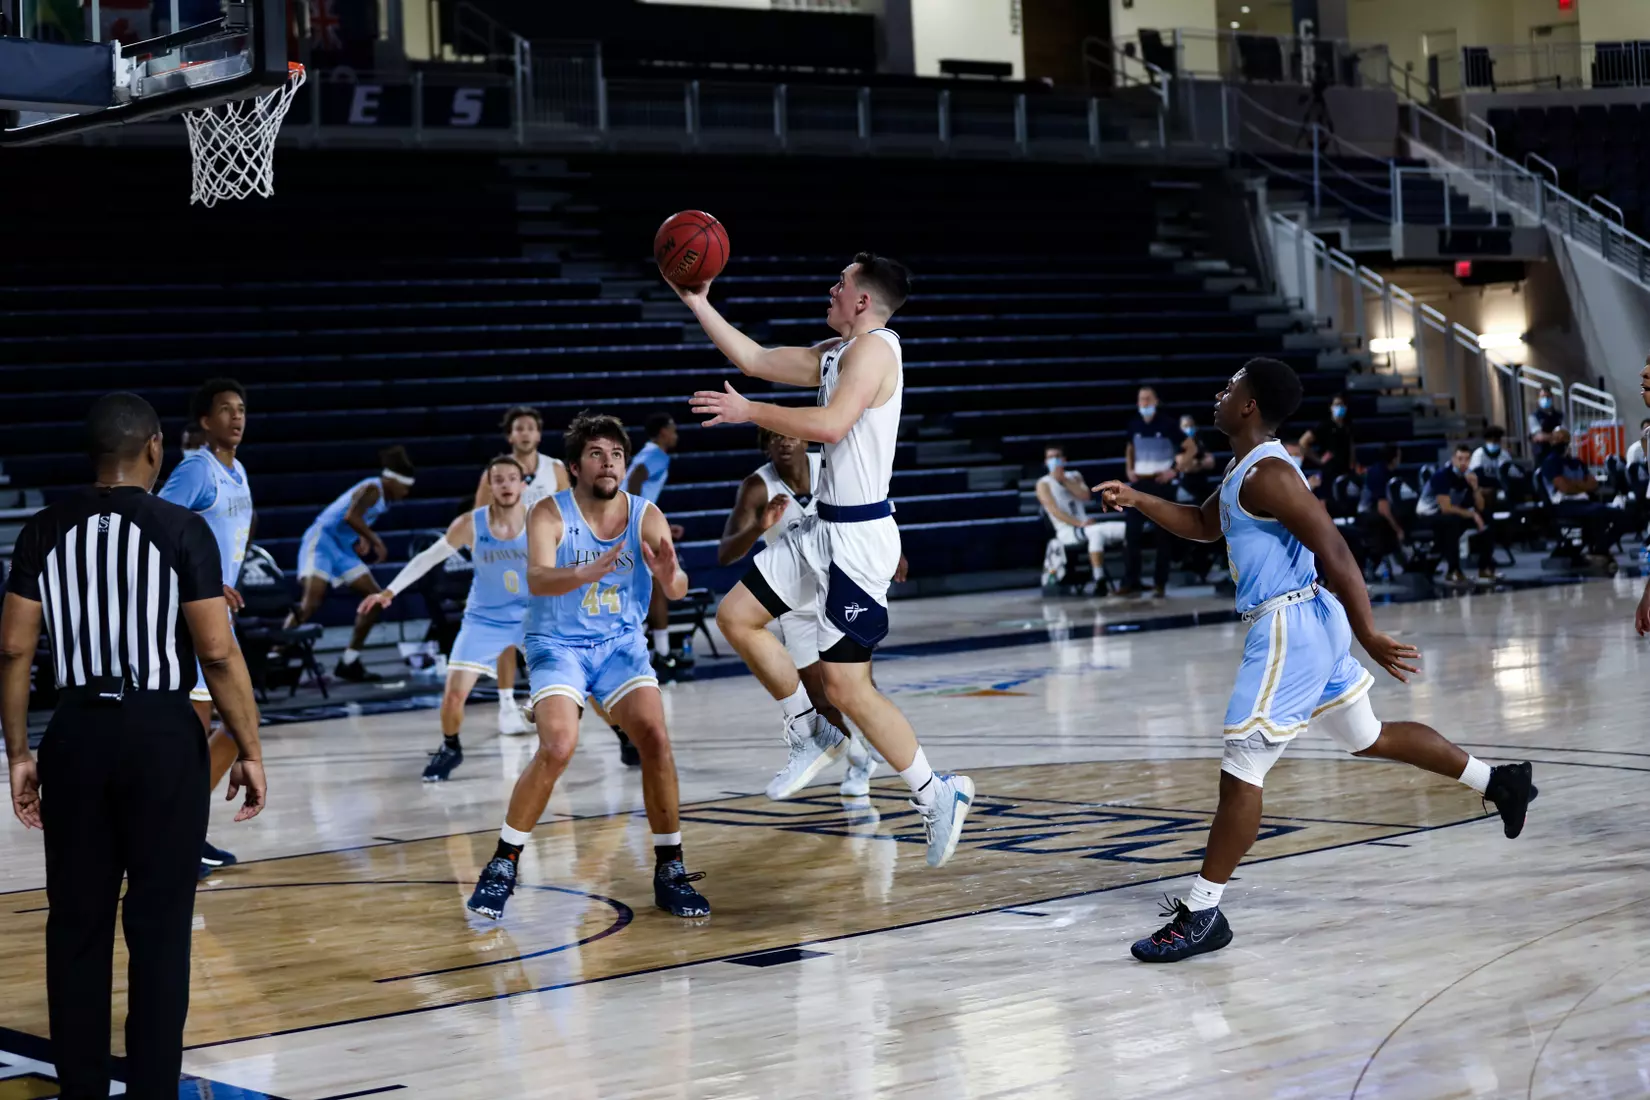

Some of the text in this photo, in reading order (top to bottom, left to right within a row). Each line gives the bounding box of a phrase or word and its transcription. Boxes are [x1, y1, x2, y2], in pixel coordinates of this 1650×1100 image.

[450, 87, 485, 126] S
[567, 549, 635, 574] HKS
[503, 570, 519, 595] 0
[581, 581, 621, 616] 44
